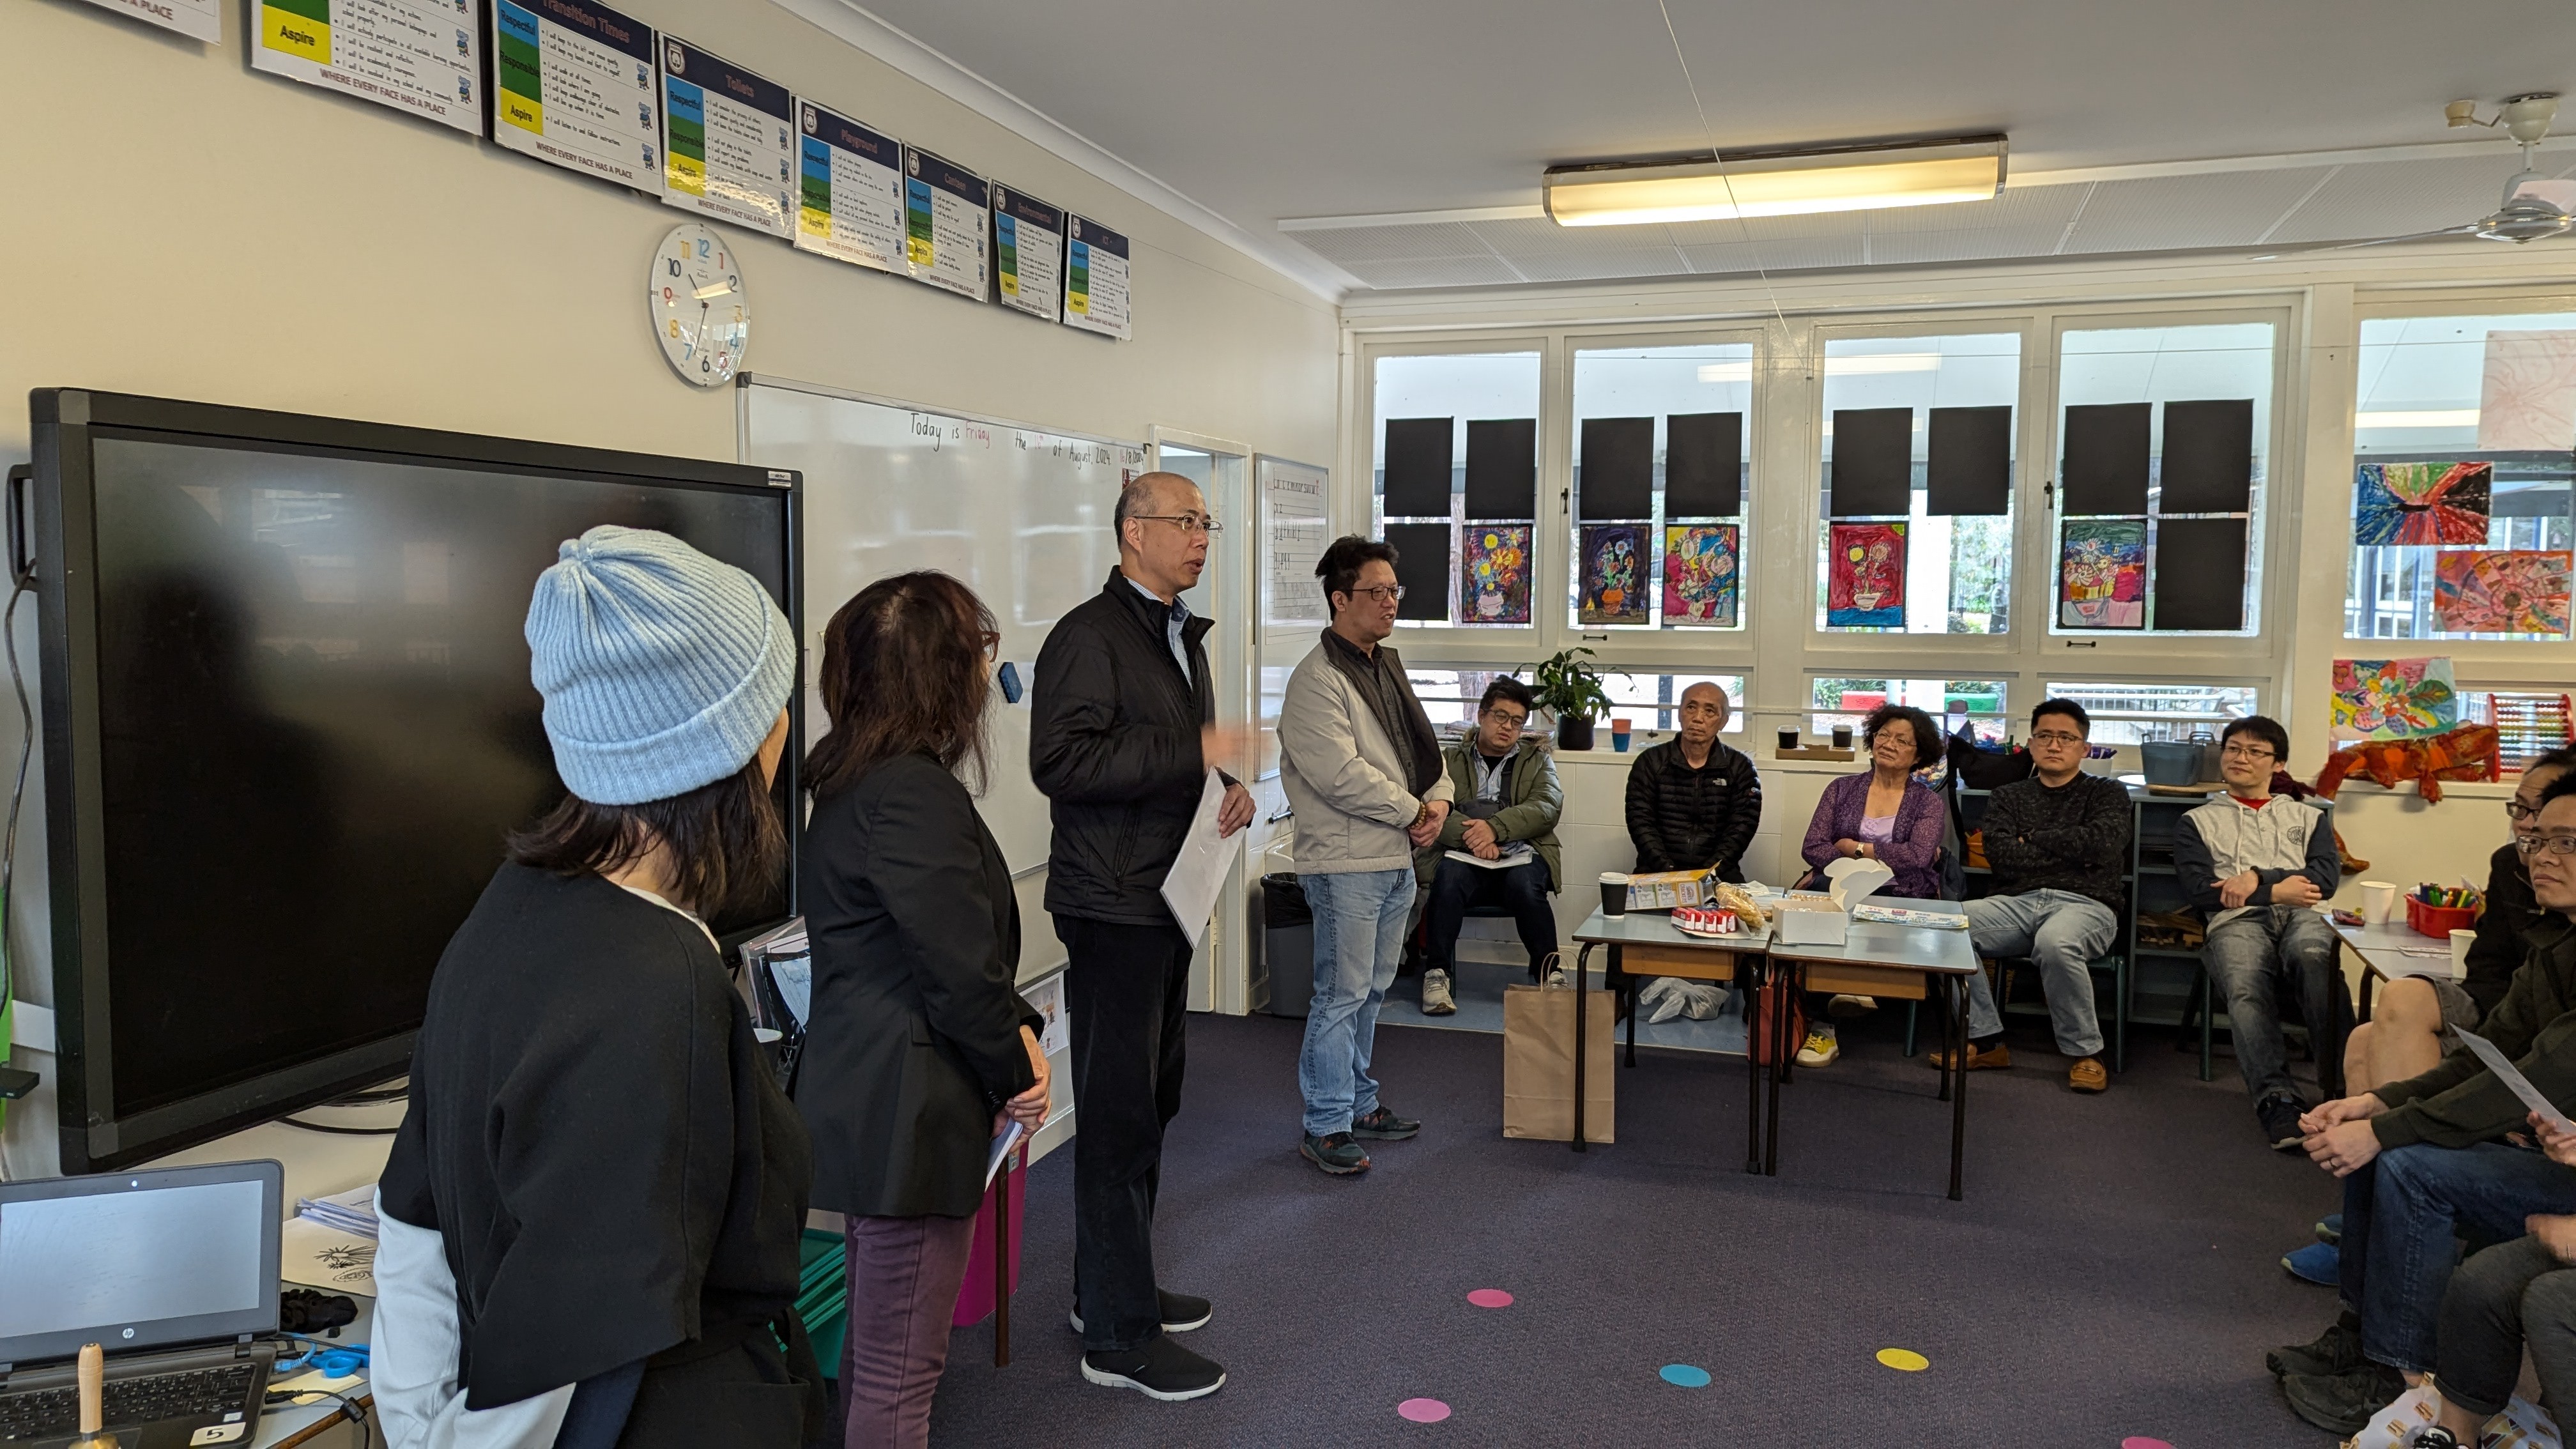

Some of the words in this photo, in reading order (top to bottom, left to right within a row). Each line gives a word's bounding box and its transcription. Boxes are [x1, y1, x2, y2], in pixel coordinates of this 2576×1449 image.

[501, 9, 536, 36] Respectful
[544, 0, 596, 29] Transition
[598, 17, 630, 43] Times
[280, 25, 315, 46] Aspire
[500, 50, 540, 79] Responsible
[320, 68, 352, 85] WHERE
[353, 79, 378, 93] EVERY
[380, 87, 399, 100] FACE
[401, 94, 416, 105] HAS
[417, 99, 423, 108] A
[424, 101, 446, 116] PLACE
[726, 75, 754, 98] Toilets
[510, 105, 532, 122] Aspire
[536, 141, 557, 156] WHERE
[558, 150, 577, 162] EVERY
[578, 156, 594, 168] FACE
[595, 162, 608, 172] HAS
[615, 167, 633, 179] PLACE
[698, 199, 715, 210] WHERE
[716, 205, 731, 214] EVERY
[731, 209, 743, 218] FACE
[743, 211, 753, 221] HAS
[758, 214, 772, 227] PLACE
[809, 217, 824, 229] Aspire
[681, 240, 690, 260] 11
[697, 239, 710, 258] 12
[826, 240, 840, 250] WHERE
[876, 254, 888, 263] PLACE
[668, 258, 681, 277] 10
[718, 252, 724, 269] 1
[729, 275, 737, 293] 2
[735, 305, 743, 323] 3
[670, 319, 679, 338] 8
[729, 332, 739, 348] 4
[684, 343, 692, 360] 7
[719, 351, 727, 369] 5
[702, 355, 710, 373] 6
[911, 413, 941, 452] Today
[952, 425, 959, 439] is
[966, 421, 990, 448] Friday
[1015, 431, 1026, 450] the
[1053, 440, 1062, 457] of
[125, 1329, 133, 1339] hp
[207, 1428, 224, 1440] 5
